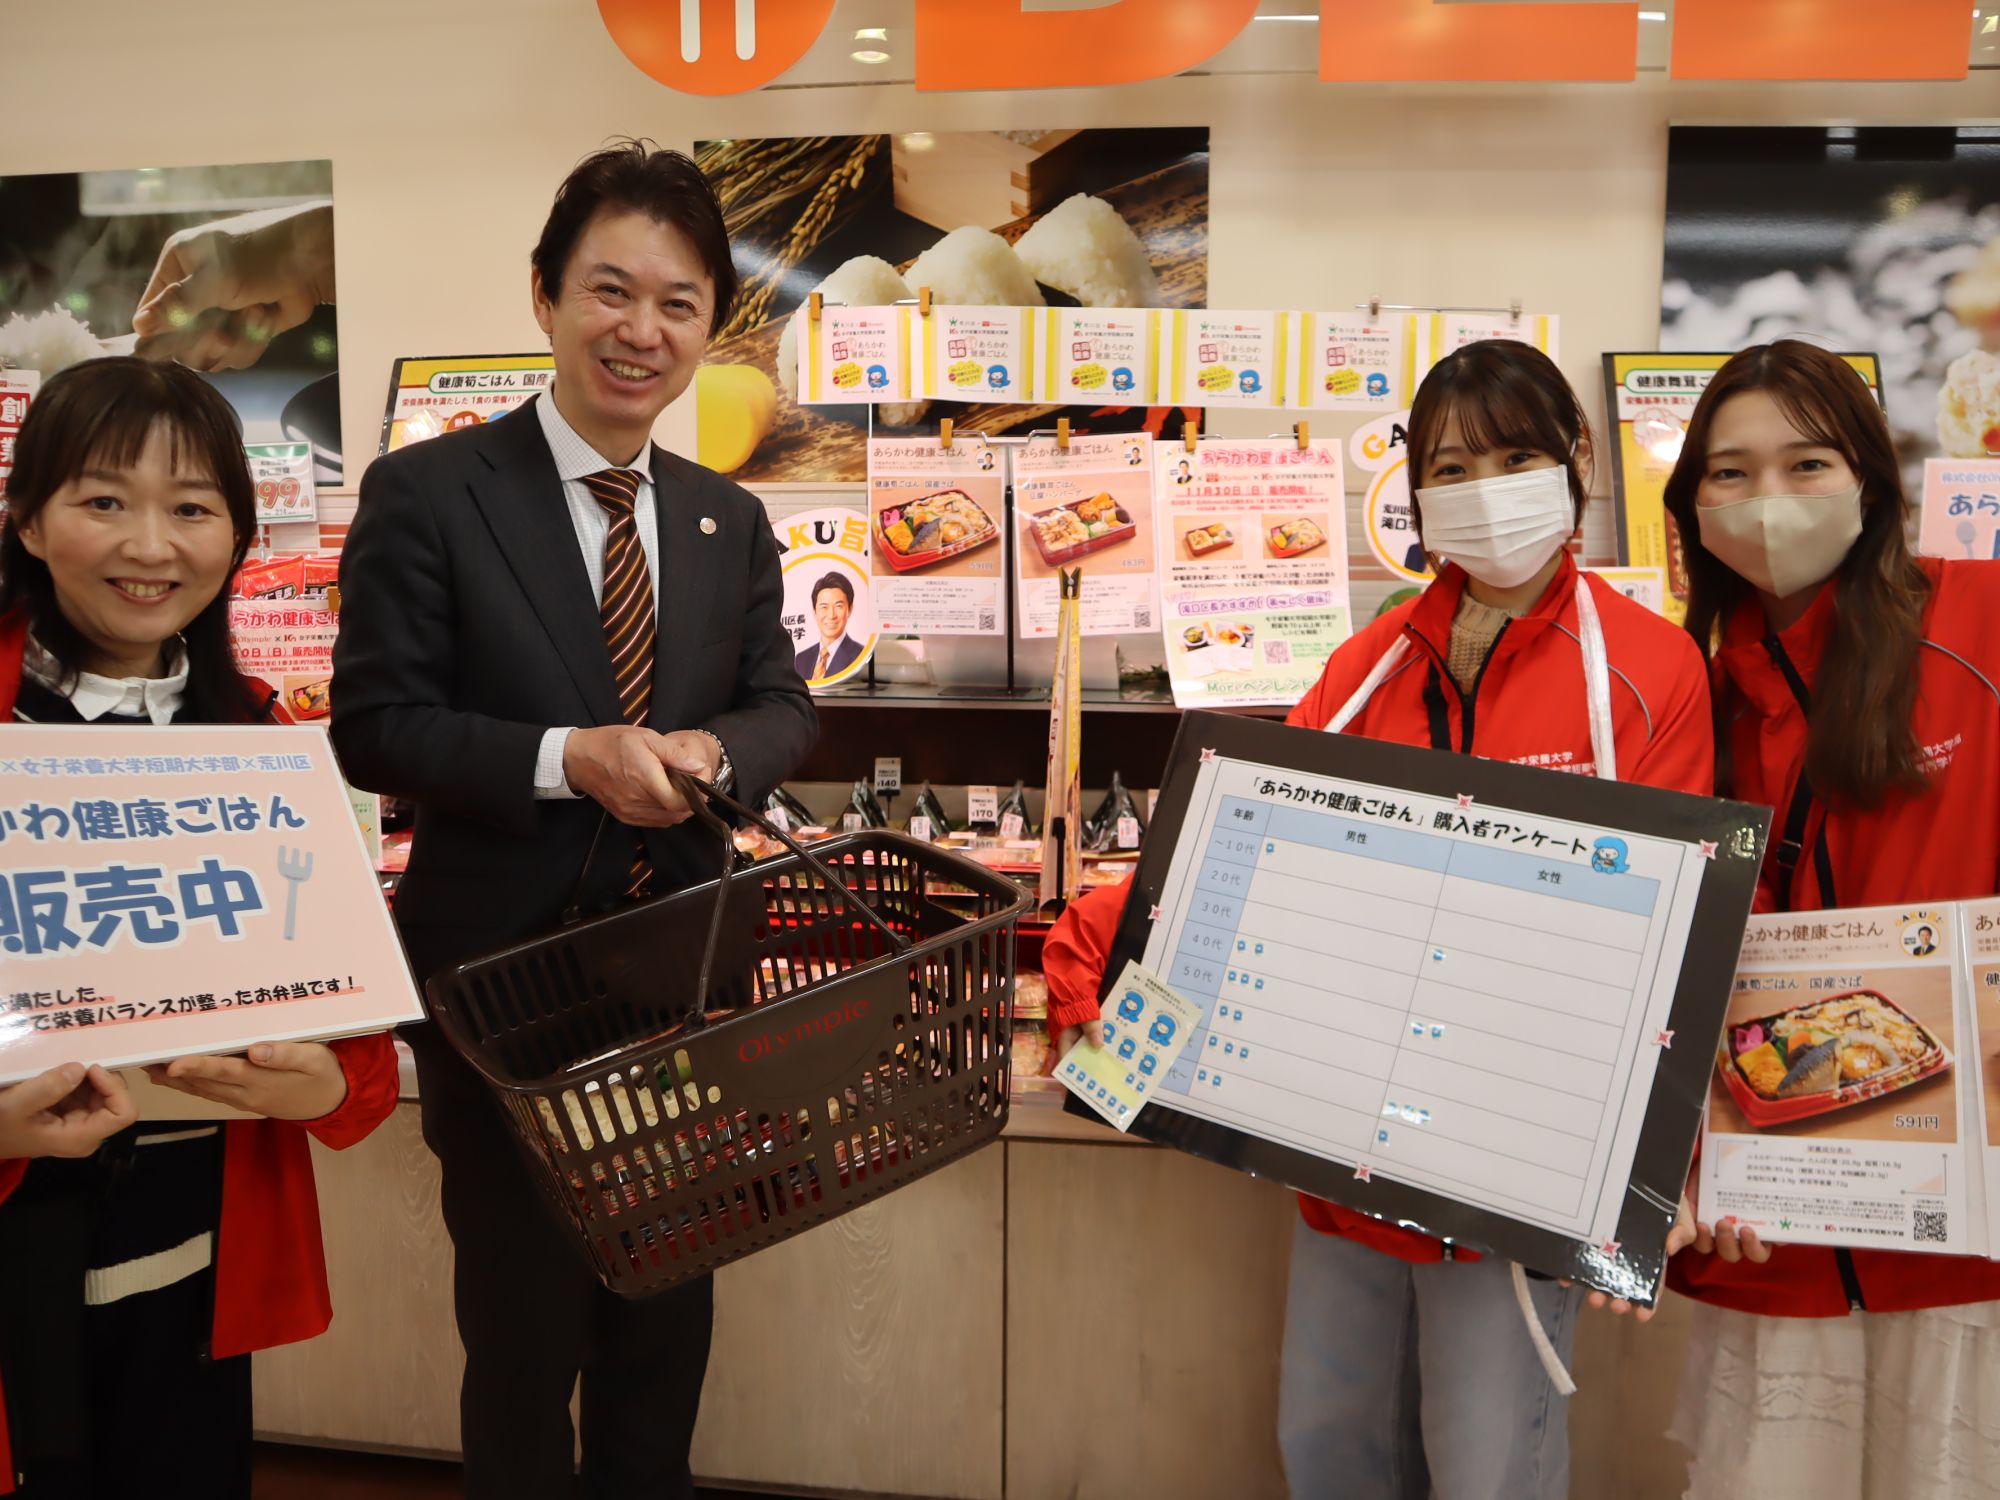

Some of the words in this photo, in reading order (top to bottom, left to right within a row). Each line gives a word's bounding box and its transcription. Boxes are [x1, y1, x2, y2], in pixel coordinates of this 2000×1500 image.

[438, 374, 516, 389] 健康筍ごはん
[873, 447, 967, 458] あらかわ健康ごはん
[1509, 752, 1573, 766] 子栄養大学
[1233, 807, 1255, 822] 年齢
[1345, 830, 1368, 845] 男性
[1210, 870, 1241, 886] 20代
[1537, 869, 1562, 885] 女性
[1201, 901, 1232, 918] 30代
[1192, 933, 1223, 950] 40代
[1183, 965, 1213, 983] 50代
[1808, 975, 1863, 989] 国産さば
[737, 999, 871, 1064] Olympic
[1895, 1115, 1939, 1129] 591円
